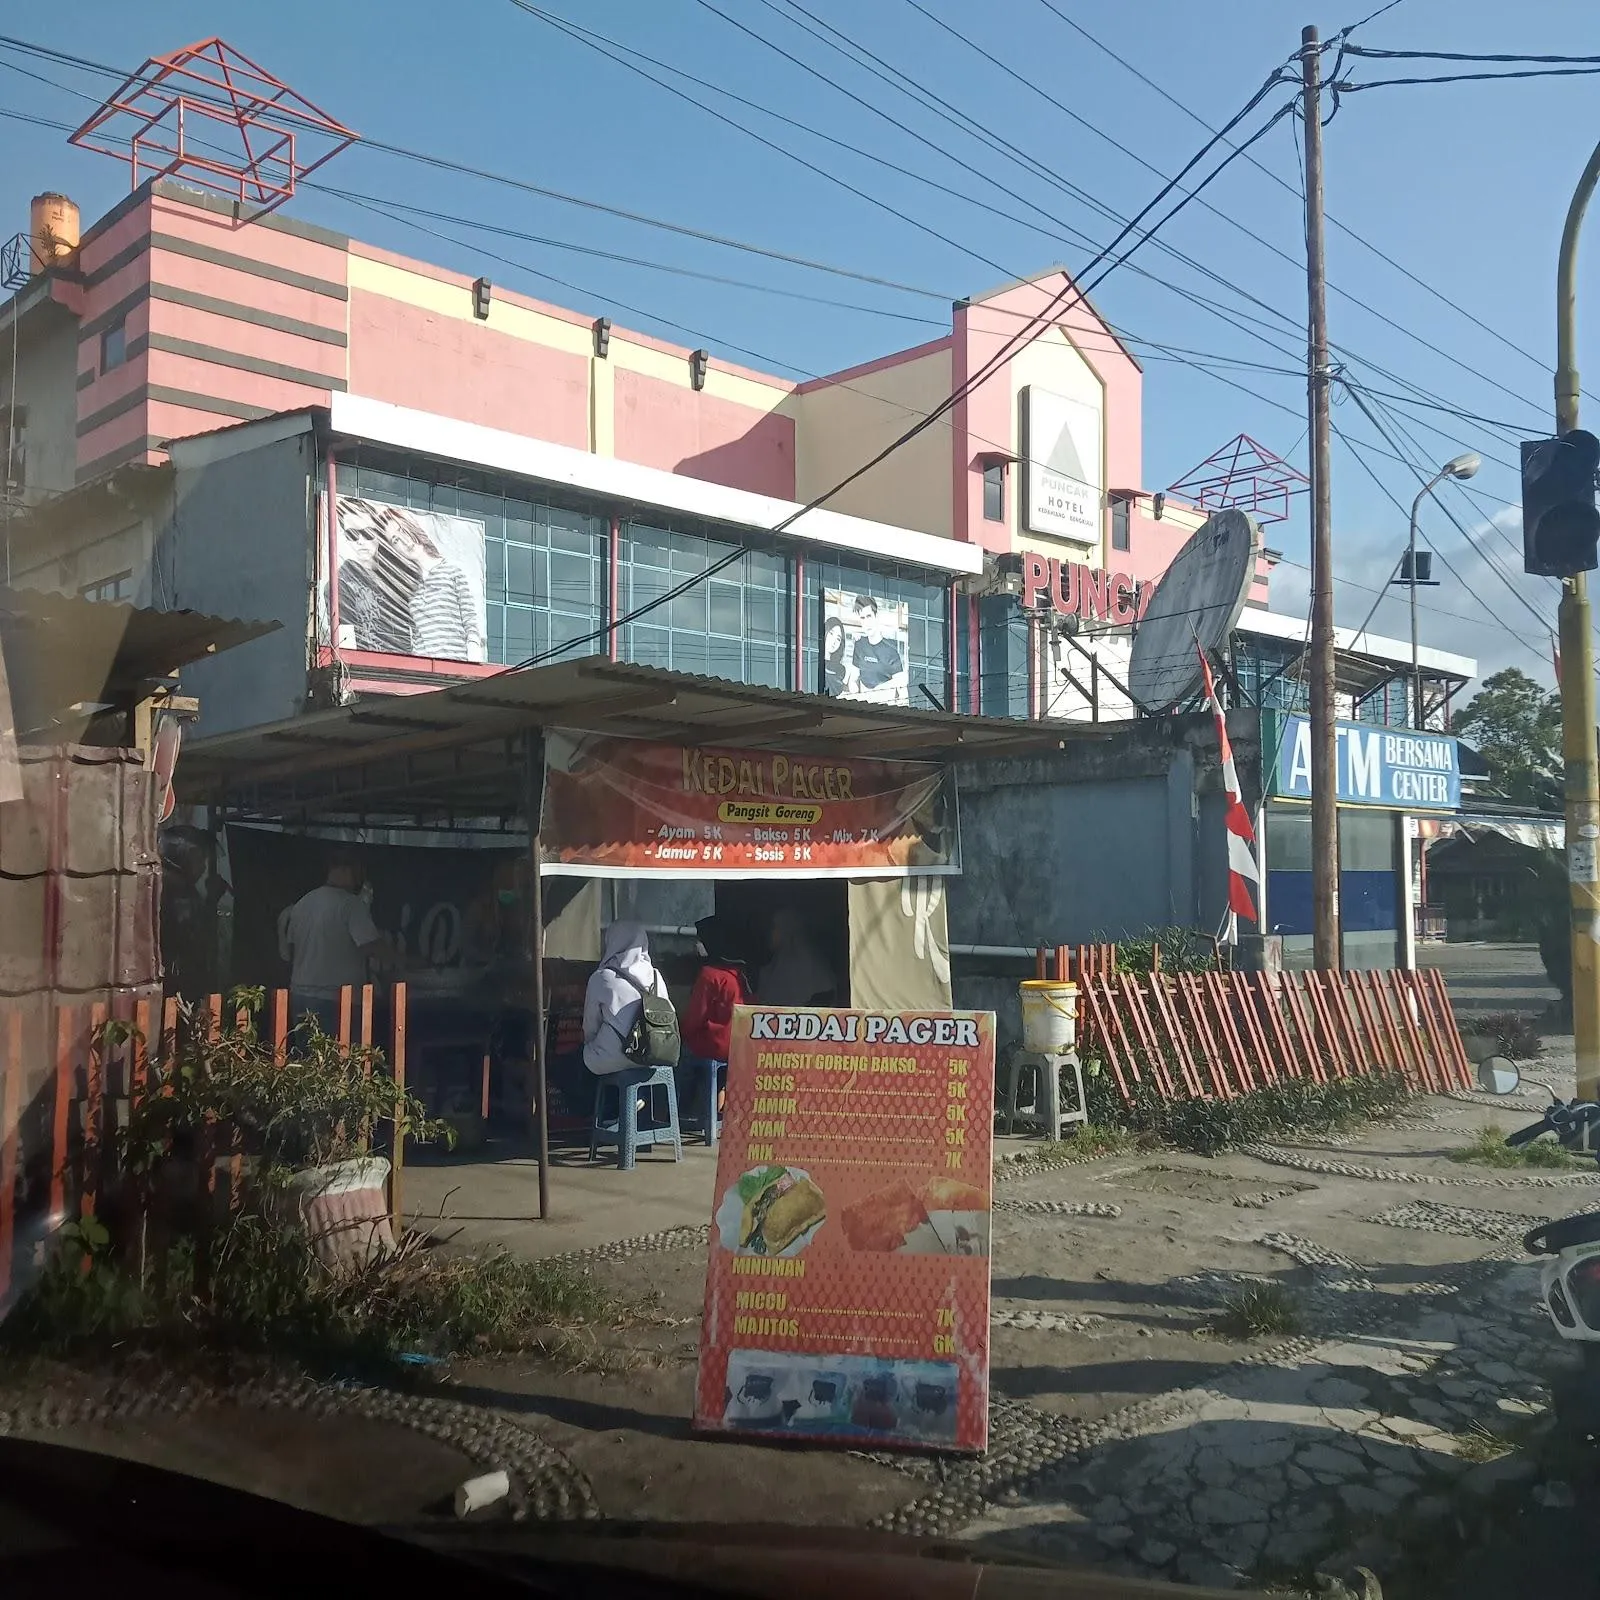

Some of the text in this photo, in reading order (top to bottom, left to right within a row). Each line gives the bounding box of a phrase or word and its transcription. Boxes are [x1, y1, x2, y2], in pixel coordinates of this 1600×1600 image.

[1041, 476, 1089, 499] PUNCAK
[1048, 495, 1083, 515] HOTEL
[1385, 735, 1453, 771] BERSAMA
[681, 747, 855, 801] KEDAI PAGER
[1391, 770, 1449, 802] CENTER
[727, 803, 816, 822] Pangsit Goreng
[658, 824, 696, 842] Ayam
[753, 827, 788, 841] Bakso
[832, 828, 853, 843] Mix
[655, 845, 698, 860] Jamur
[754, 847, 785, 861] Sosis
[750, 1013, 980, 1047] KEDAI PAGER
[757, 1053, 812, 1070] PANGSIT
[815, 1054, 868, 1072] GORENG
[948, 1058, 969, 1076] 5K
[755, 1075, 967, 1099] SOSIS 5K
[752, 1097, 967, 1122] JAMUR 5K
[749, 1120, 966, 1145] AYAM 5K
[747, 1143, 773, 1161] MIX
[732, 1258, 806, 1278] MINUMAN
[735, 1291, 955, 1328] MICCU 7K
[734, 1316, 799, 1337] MAJITOS
